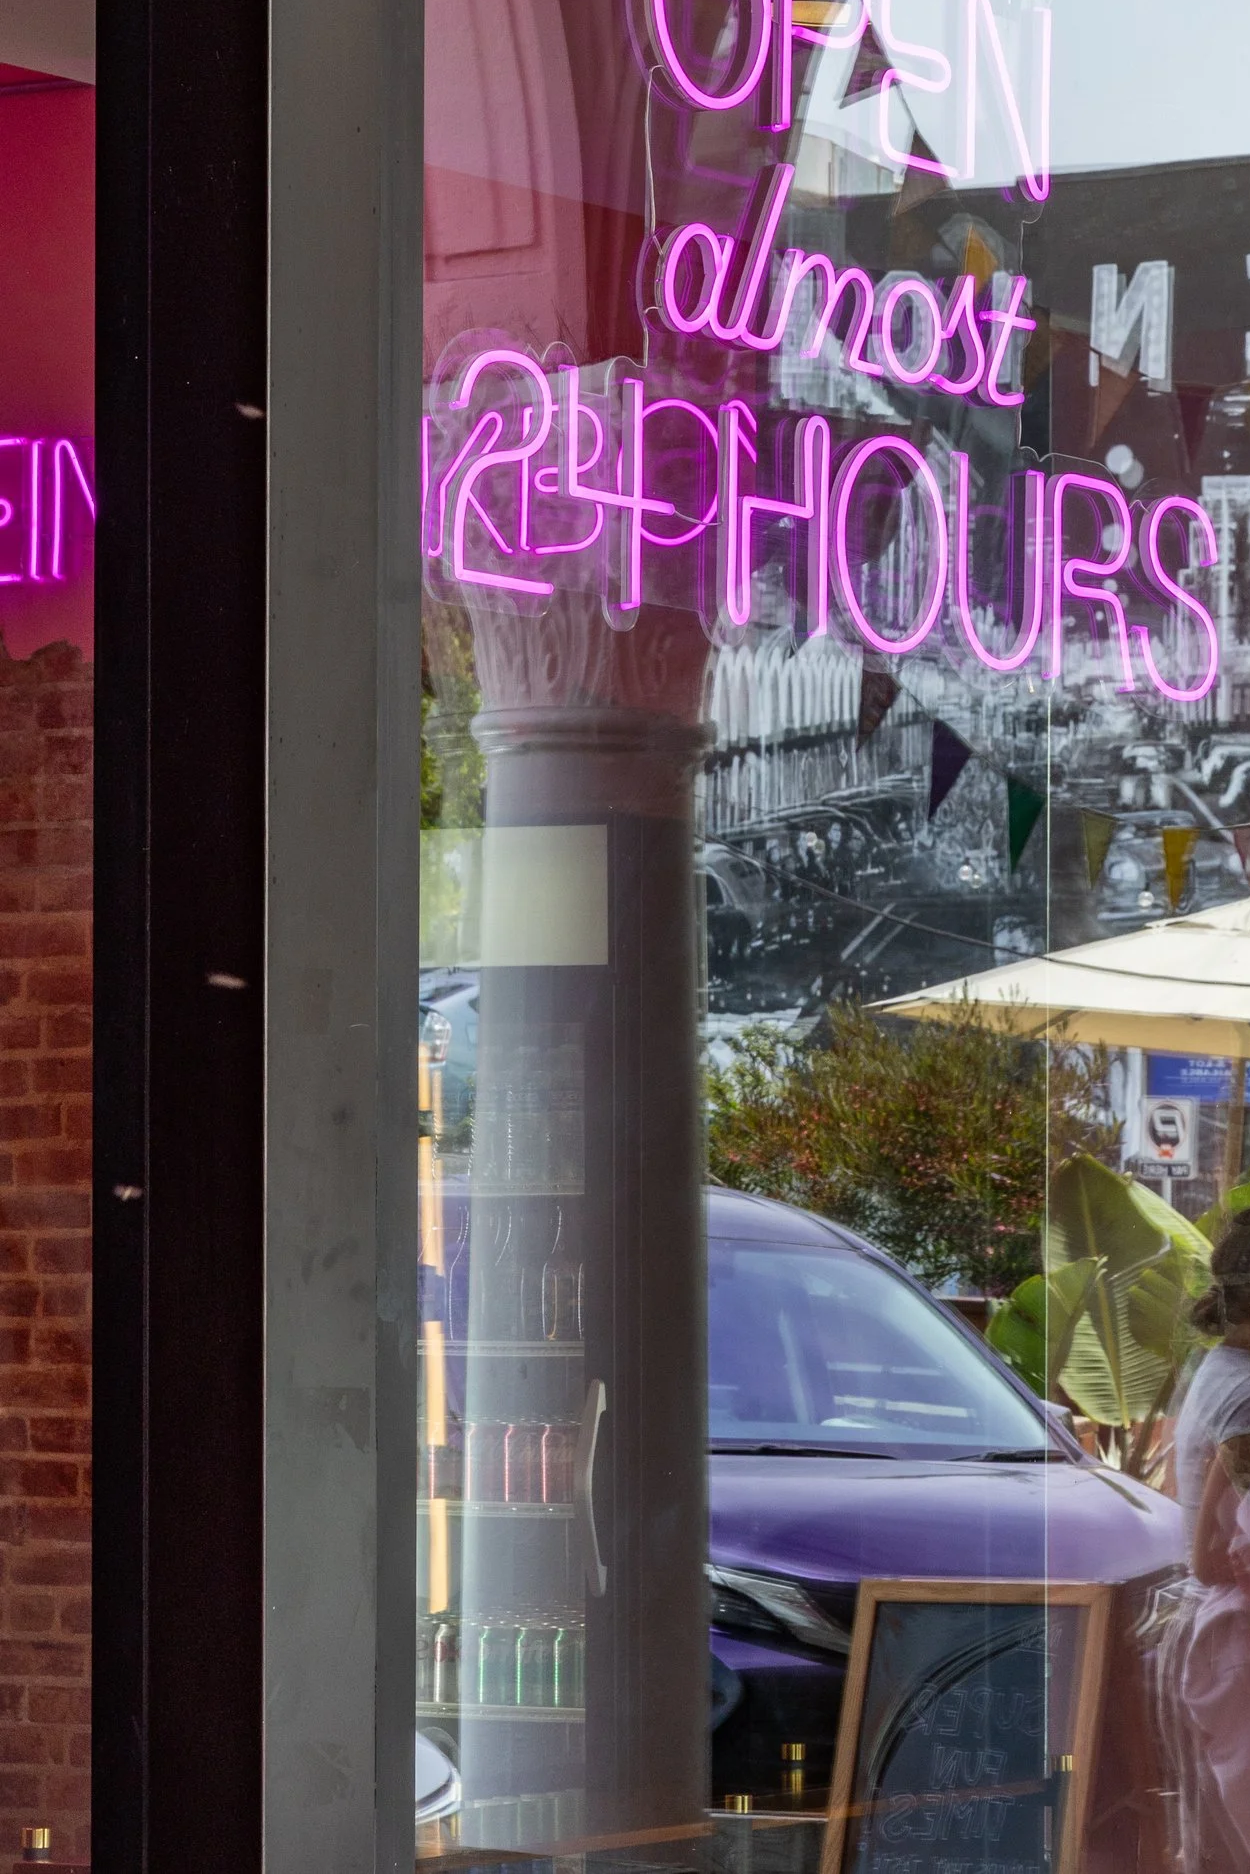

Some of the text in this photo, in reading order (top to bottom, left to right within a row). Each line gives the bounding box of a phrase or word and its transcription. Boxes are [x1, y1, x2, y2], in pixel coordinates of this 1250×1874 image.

[660, 162, 1037, 406] almost
[450, 349, 1218, 702] 24 HOURS
